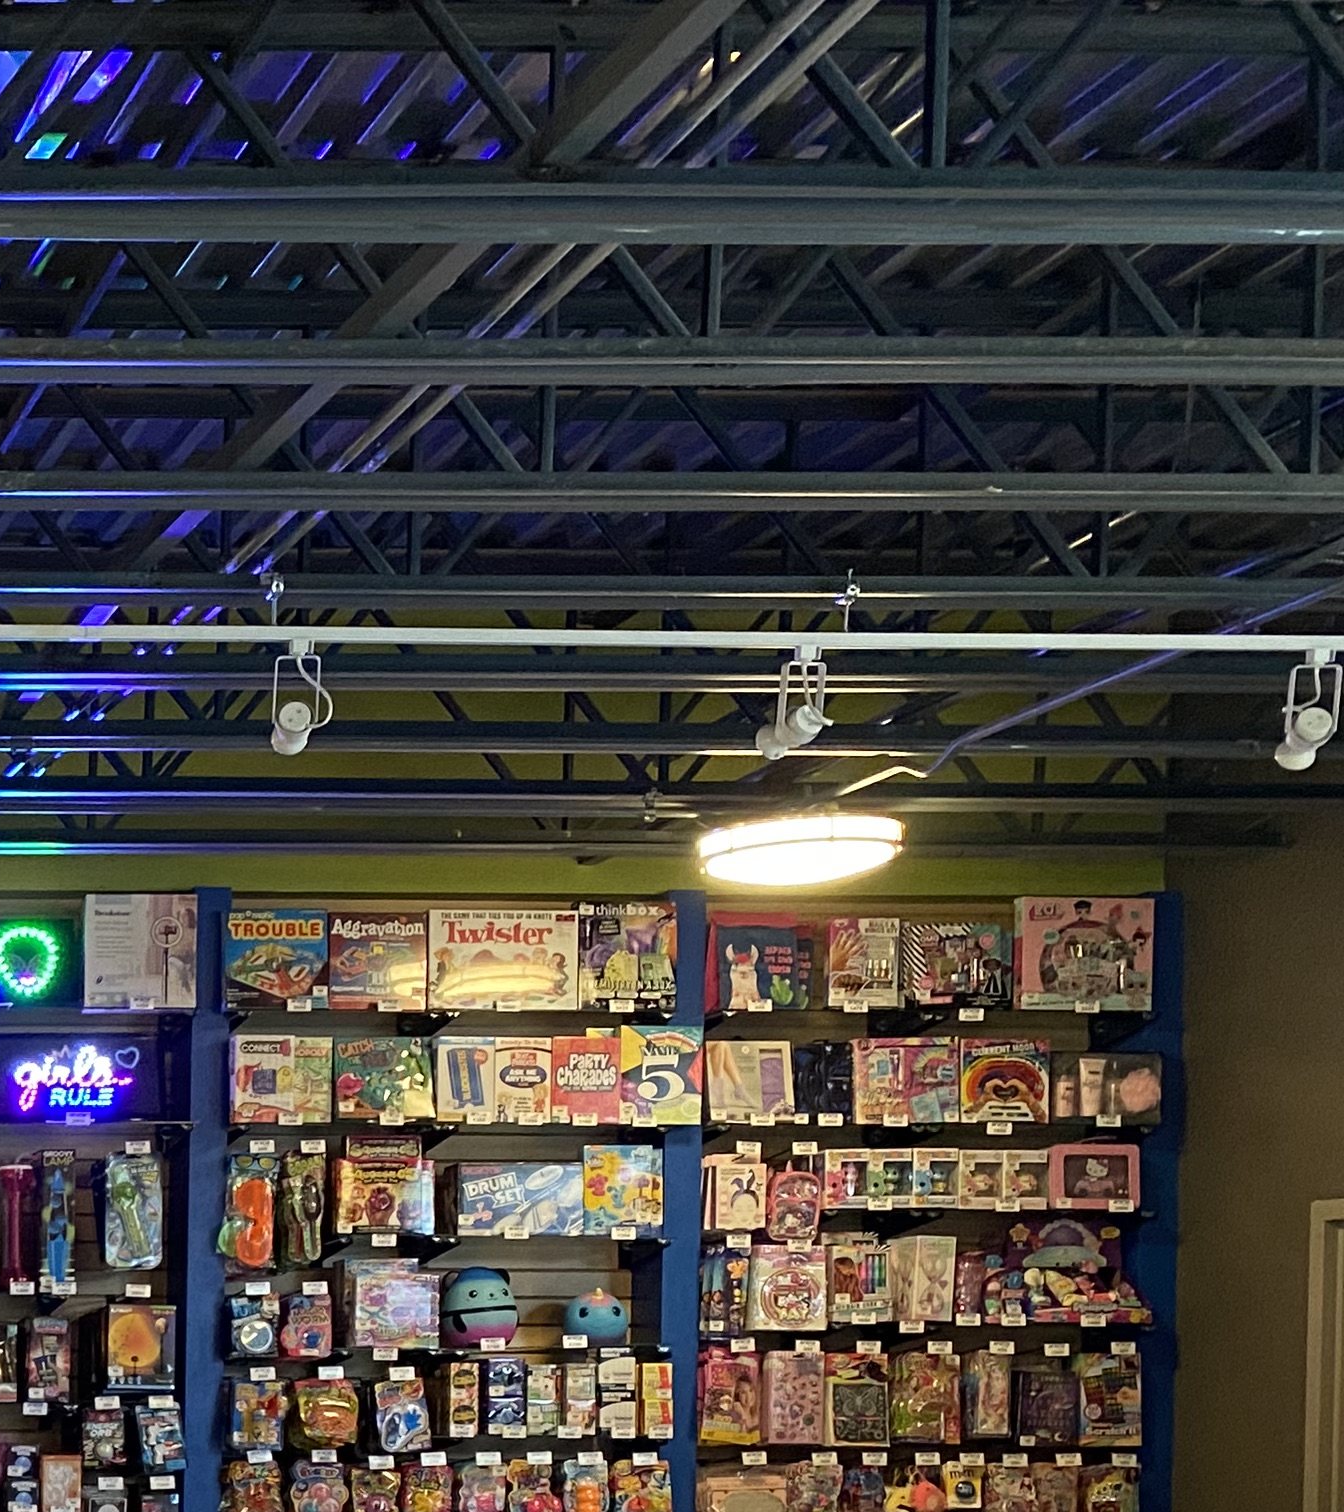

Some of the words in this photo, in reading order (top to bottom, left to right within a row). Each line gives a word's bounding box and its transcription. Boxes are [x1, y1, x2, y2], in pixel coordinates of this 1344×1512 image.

[441, 912, 452, 920] THE
[453, 912, 470, 920] GAME
[472, 912, 487, 920] THAT
[488, 912, 501, 920] TIES
[503, 912, 515, 920] YOU
[515, 912, 524, 920] UP
[533, 912, 553, 920] KNOTS
[230, 921, 322, 938] TROUBLE
[331, 917, 425, 940] Aggravation
[442, 919, 554, 946] Twister
[241, 1042, 283, 1053] CONNECT
[637, 1053, 686, 1102] 5
[49, 1087, 114, 1107] RULE
[43, 1156, 75, 1167] LAMP
[467, 1174, 517, 1196] DRUM
[494, 1186, 524, 1206] SET
